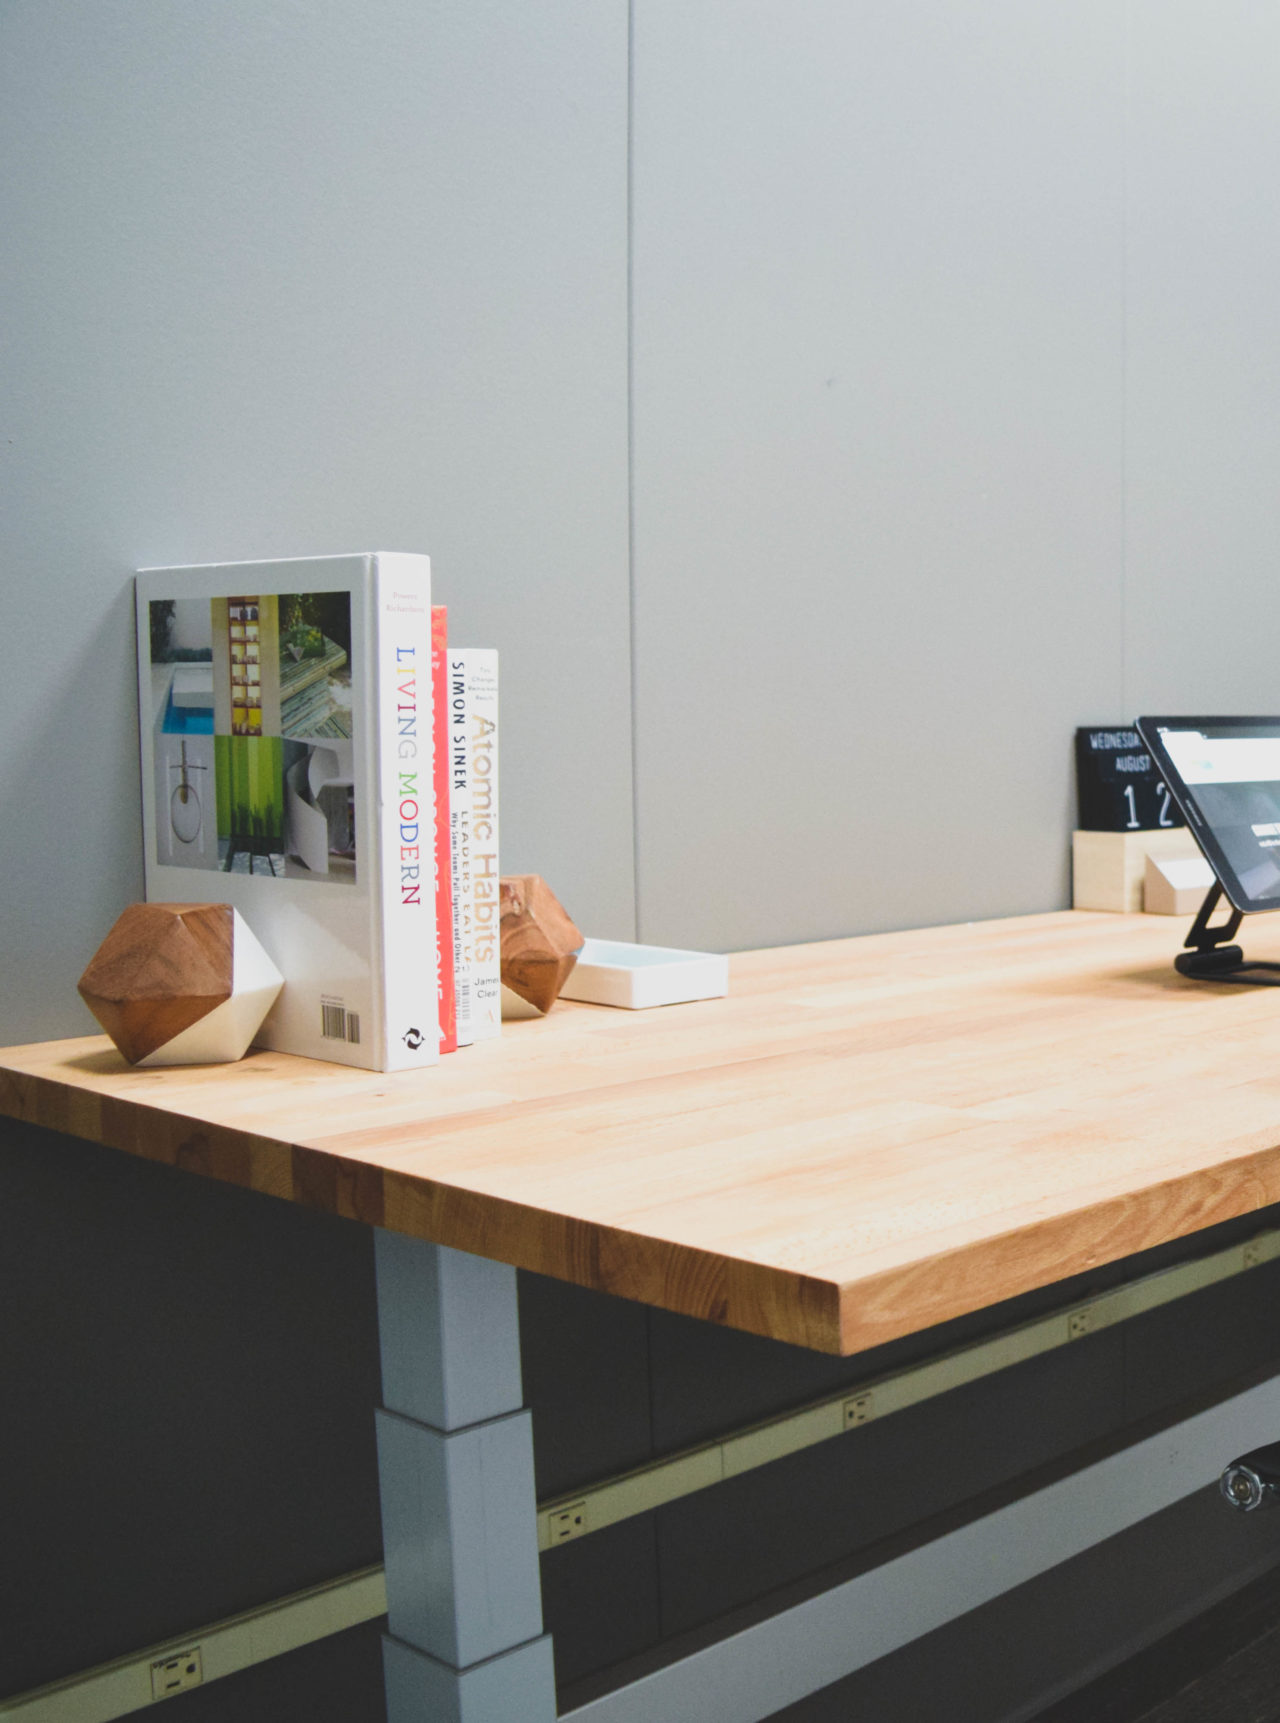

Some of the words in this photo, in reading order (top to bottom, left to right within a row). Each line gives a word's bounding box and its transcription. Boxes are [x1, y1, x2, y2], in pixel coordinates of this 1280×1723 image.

[396, 647, 417, 759] LIVING
[452, 662, 466, 724] SIMON
[453, 736, 467, 789] SINEK
[472, 715, 496, 840] Atomic
[1090, 732, 1142, 749] WEDNESDA
[1115, 754, 1151, 772] AUGUST
[398, 772, 421, 905] MODERN
[473, 853, 498, 963] Habits
